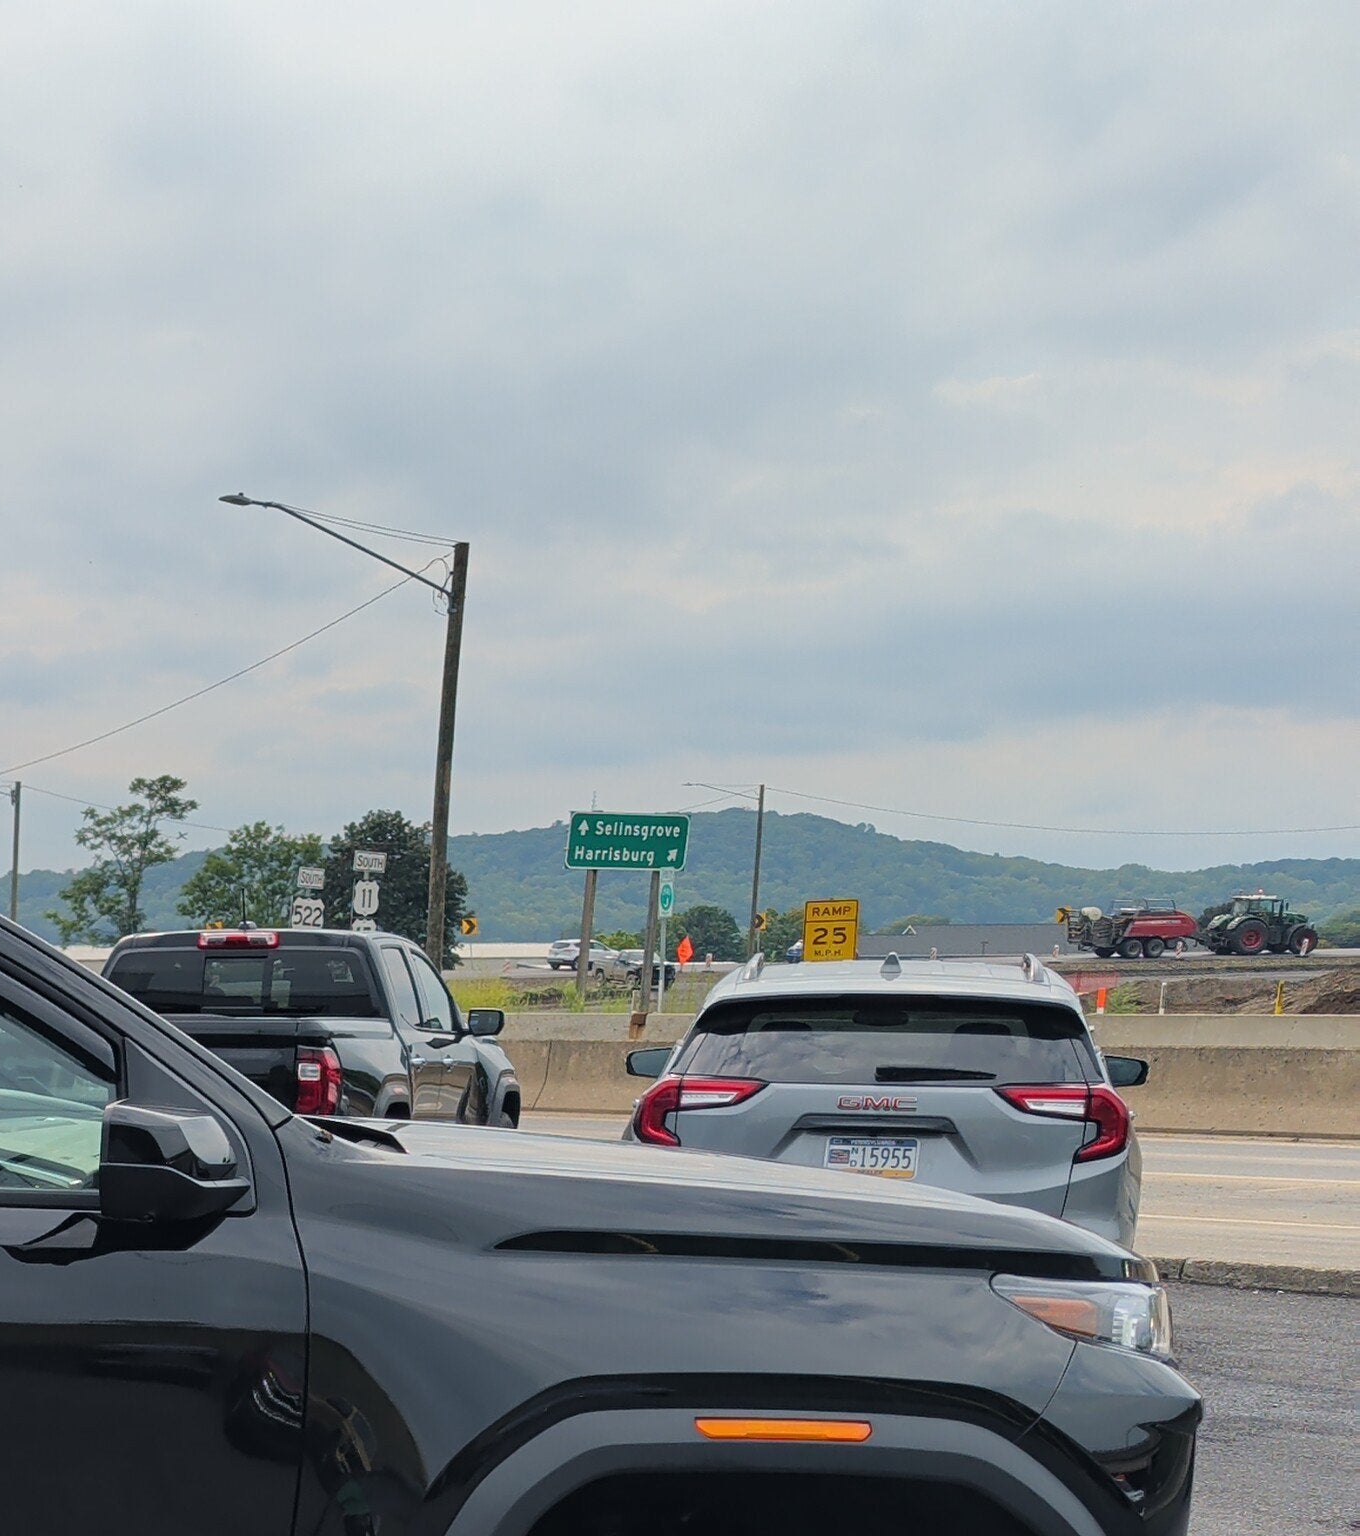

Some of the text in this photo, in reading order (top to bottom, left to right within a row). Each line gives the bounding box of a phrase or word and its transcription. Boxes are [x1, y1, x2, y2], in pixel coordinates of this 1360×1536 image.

[595, 820, 681, 841] Selinsgrove
[574, 846, 655, 866] Harrisburg
[361, 888, 373, 909] 11
[292, 905, 323, 927] 522
[812, 906, 852, 917] RAMP
[812, 926, 848, 945] 25
[837, 1095, 918, 1112] GMC
[860, 1147, 913, 1169] 15955
